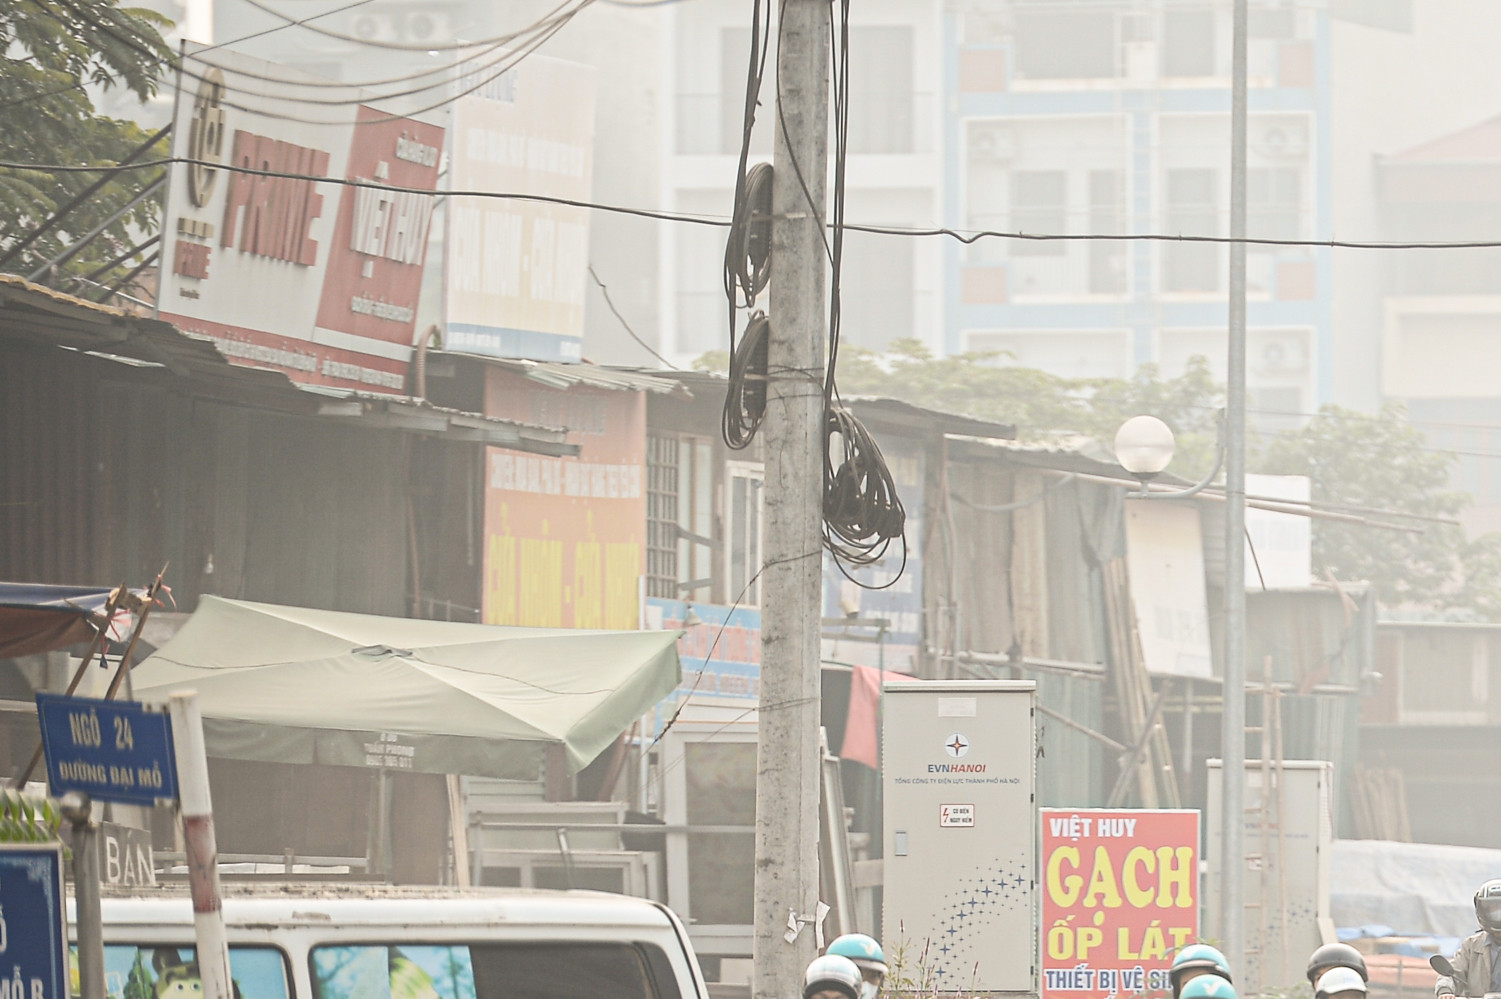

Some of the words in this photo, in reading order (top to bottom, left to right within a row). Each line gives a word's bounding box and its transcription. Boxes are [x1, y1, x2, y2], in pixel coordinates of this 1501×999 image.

[220, 129, 331, 268] PRIME
[69, 706, 102, 748] NGÕ
[113, 716, 134, 750] 24
[59, 757, 107, 785] ĐƯỜNG
[110, 766, 135, 790] ĐẠI
[138, 760, 162, 788] MỖ
[928, 764, 986, 773] EVNHANOI
[1050, 814, 1092, 841] VIỆT
[1098, 818, 1136, 838] HUY
[106, 831, 156, 886] BÁN
[1046, 845, 1193, 926] GẠCH
[1048, 915, 1103, 960] ỐP
[1118, 920, 1192, 960] LÁT
[1045, 963, 1094, 990] THIẾT
[1099, 969, 1117, 994] BỊ
[1122, 966, 1144, 994] VỆ
